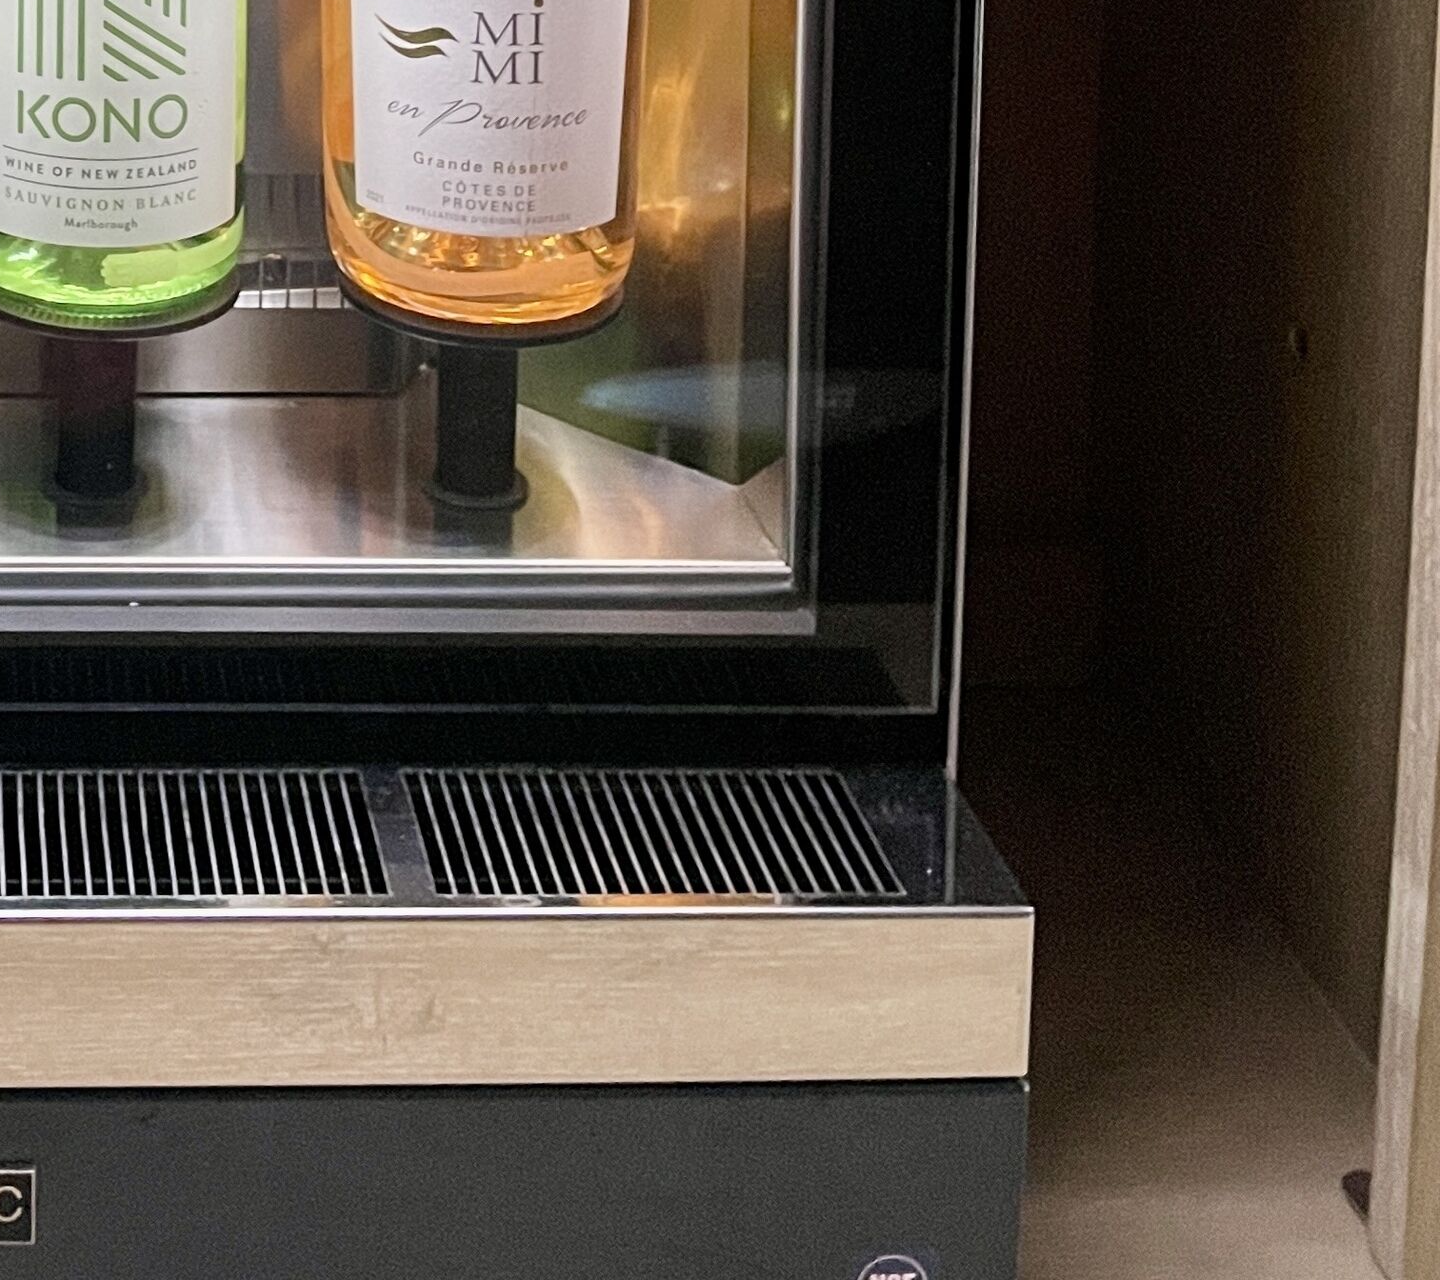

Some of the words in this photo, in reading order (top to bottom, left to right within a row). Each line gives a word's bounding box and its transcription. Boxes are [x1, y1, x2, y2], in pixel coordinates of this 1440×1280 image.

[470, 49, 544, 85] MI
[17, 89, 188, 143] KONO
[387, 99, 423, 120] en
[418, 98, 587, 137] Provence
[5, 156, 44, 174] WINE
[52, 166, 73, 178] OF
[81, 169, 118, 180] NEW
[126, 159, 197, 179] ZEALAND
[413, 151, 483, 173] Grande
[5, 186, 124, 211] SAUVIGNON
[136, 189, 197, 210] BLANC
[514, 183, 537, 197] DE
[442, 196, 536, 213] PROVENCE
[64, 218, 138, 231] Marlborough
